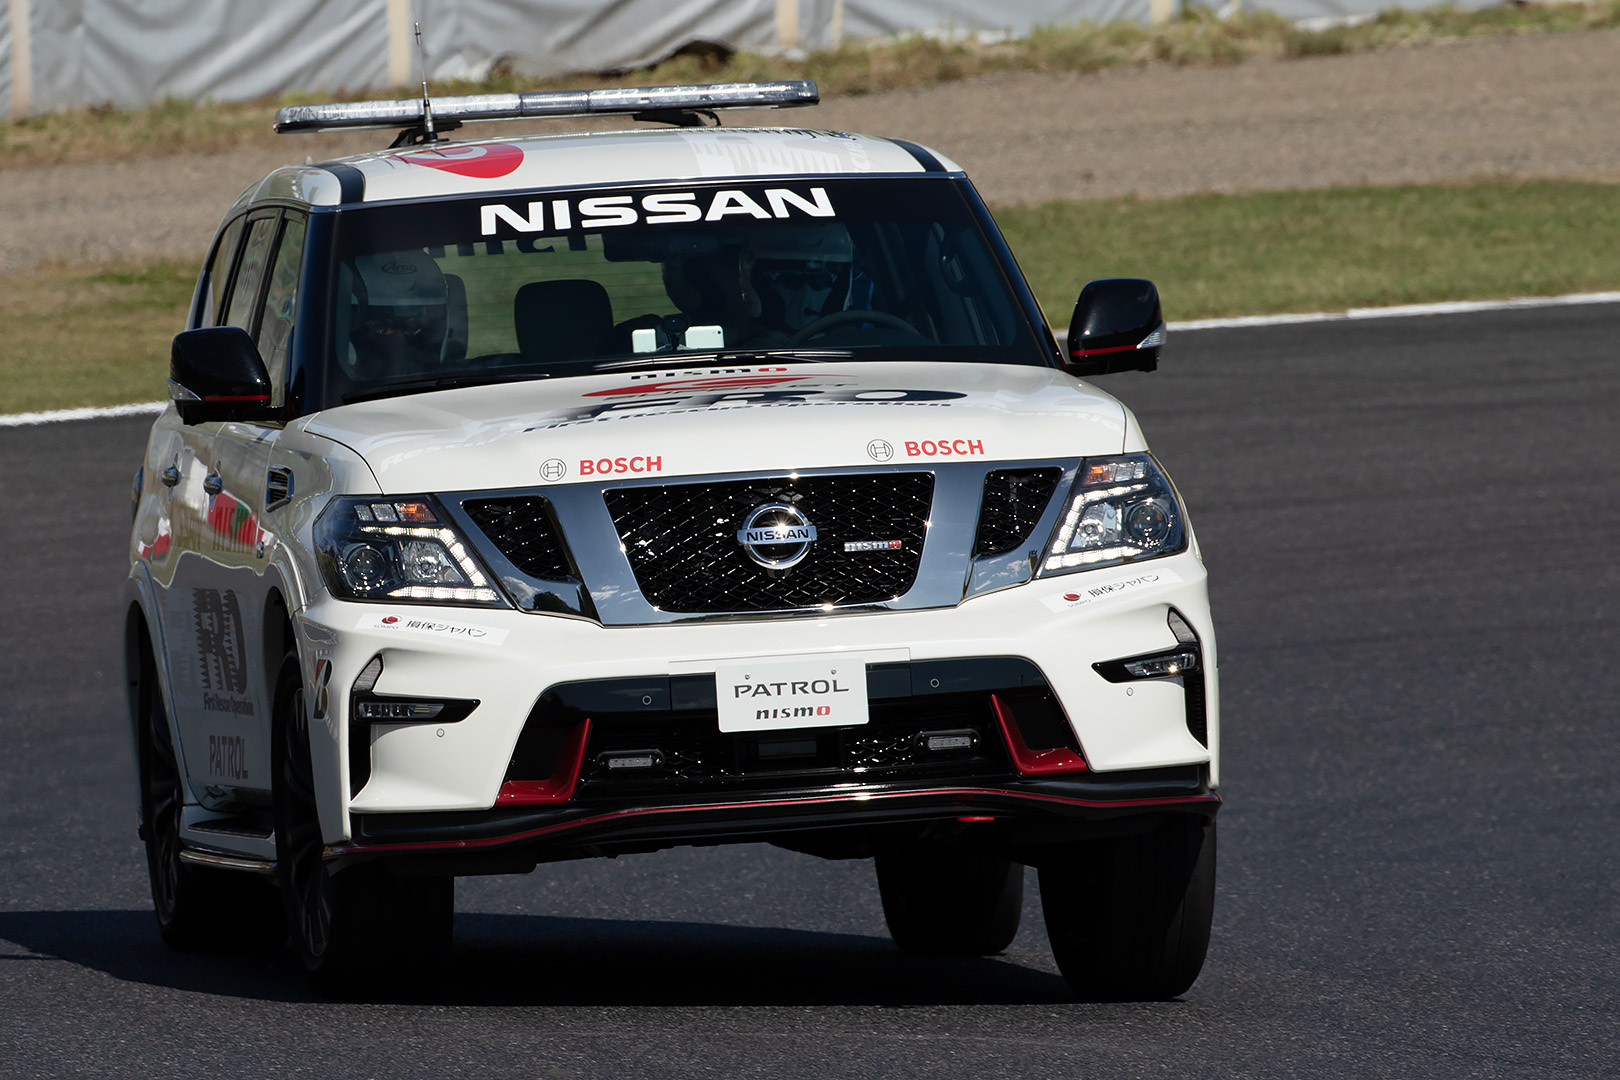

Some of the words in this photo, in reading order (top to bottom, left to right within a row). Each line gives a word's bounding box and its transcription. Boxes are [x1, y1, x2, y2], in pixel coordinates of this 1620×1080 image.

[480, 187, 836, 236] NISSAN
[631, 367, 788, 380] nismo
[904, 439, 985, 457] BOSCH
[580, 456, 662, 475] BOSCH
[746, 528, 810, 542] NISSAN
[845, 540, 902, 551] nismo
[1088, 575, 1159, 597] 損保ジャパン
[405, 619, 487, 637] 損保ジャパン
[733, 679, 850, 699] PATROL
[756, 705, 831, 720] nismo
[209, 735, 249, 780] PATROL
